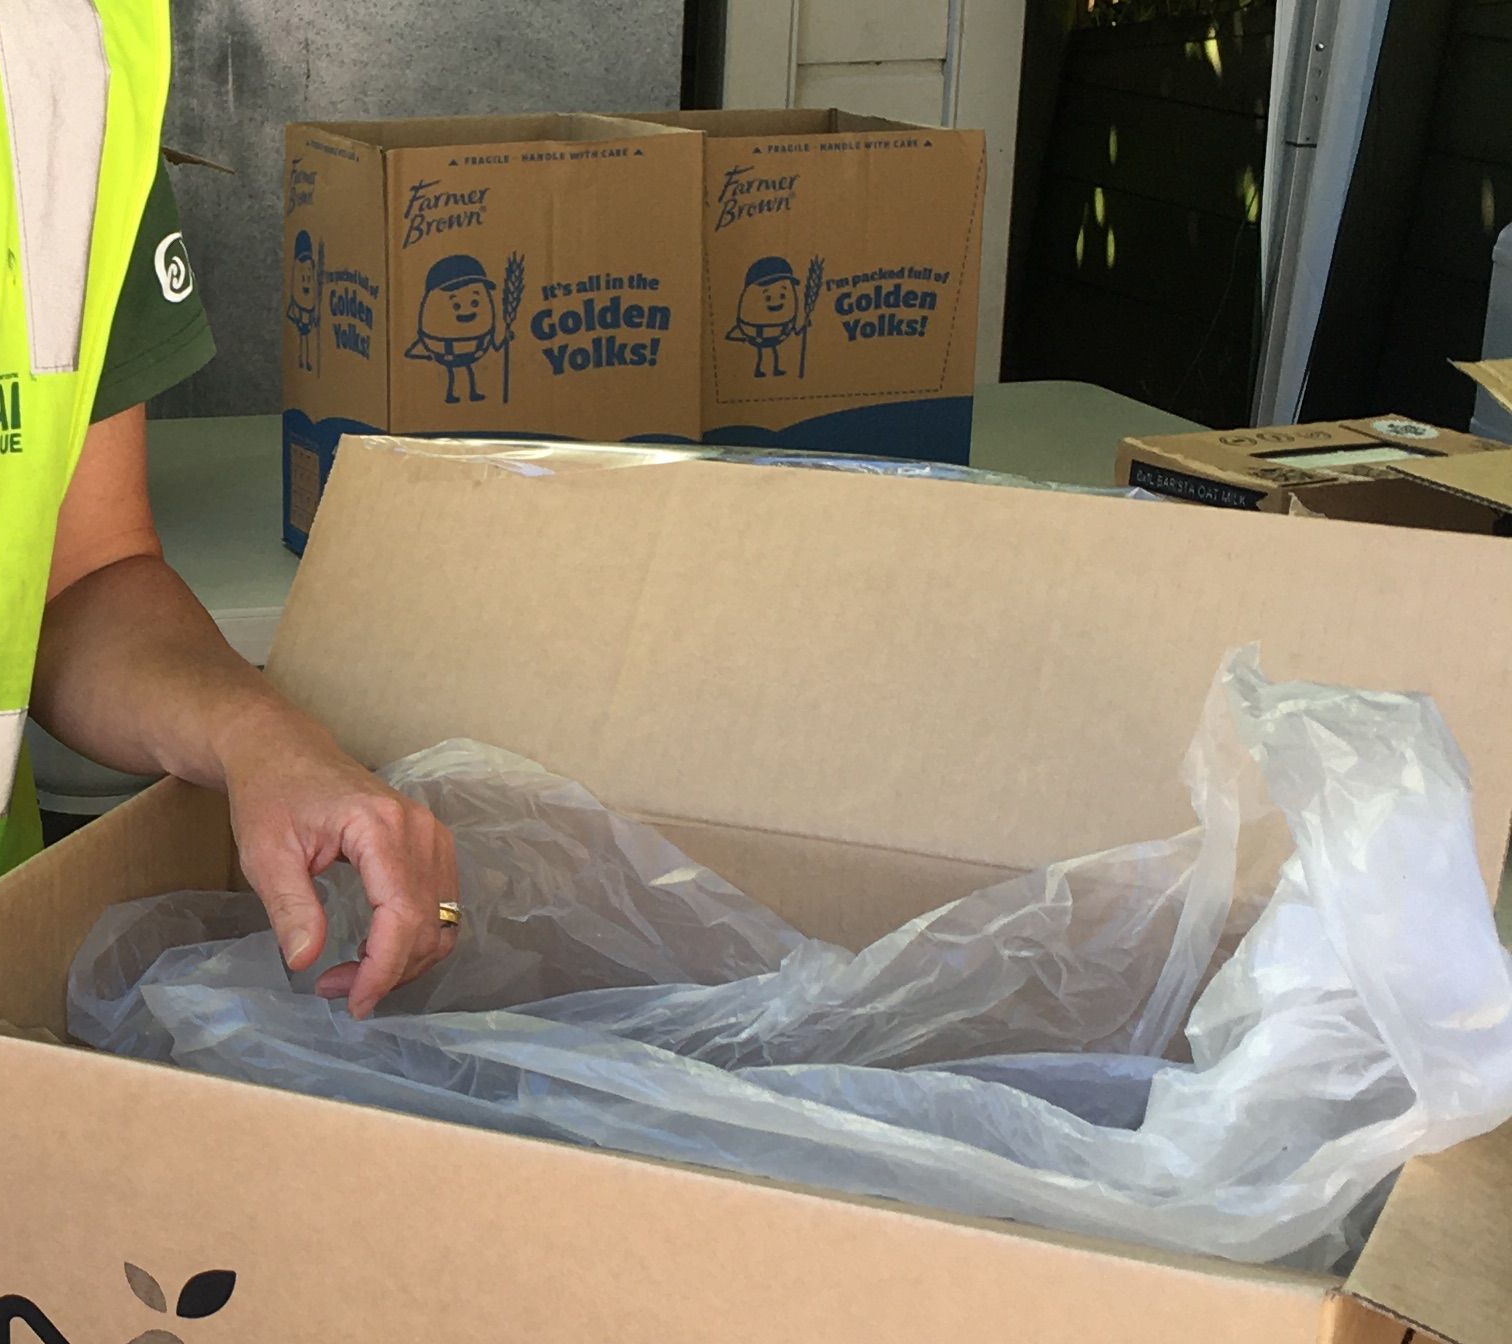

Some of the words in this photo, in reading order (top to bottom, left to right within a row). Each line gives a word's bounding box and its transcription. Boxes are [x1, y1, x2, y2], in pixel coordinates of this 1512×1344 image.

[404, 179, 491, 219] Farmer
[717, 165, 801, 203] Farmer
[402, 210, 484, 249] Brown
[542, 282, 573, 301] It's
[576, 275, 601, 293] all
[605, 273, 624, 290] in
[628, 273, 660, 290] the
[852, 267, 905, 288] packed
[908, 266, 933, 280] full
[330, 287, 374, 330] Golden
[530, 296, 672, 341] Golden
[835, 284, 938, 316] Golden
[842, 313, 929, 341] Yolks!
[542, 336, 661, 375] Yolks!
[1197, 485, 1219, 501] OAT
